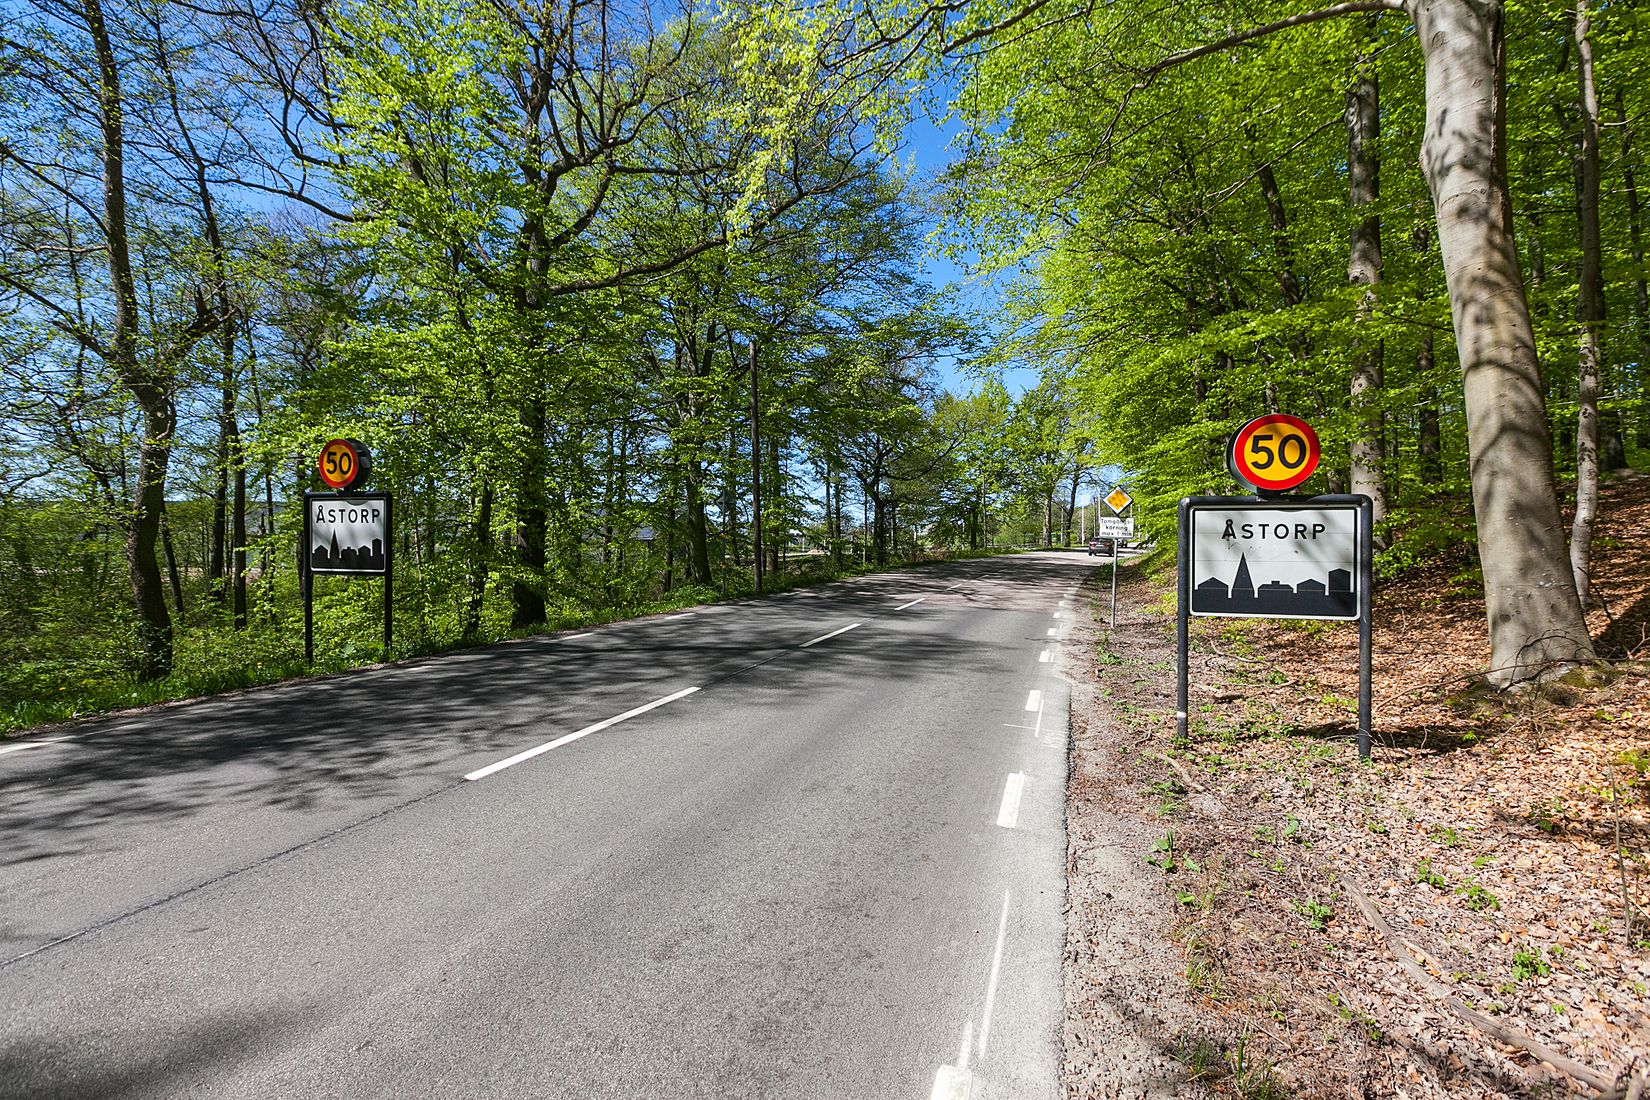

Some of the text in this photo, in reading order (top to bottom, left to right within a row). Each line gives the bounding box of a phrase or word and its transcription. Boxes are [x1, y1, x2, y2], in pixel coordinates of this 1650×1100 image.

[325, 451, 352, 475] 50
[1250, 434, 1307, 470] 50
[315, 505, 380, 524] ÅSTORP
[1221, 518, 1326, 540] ÅSTORP
